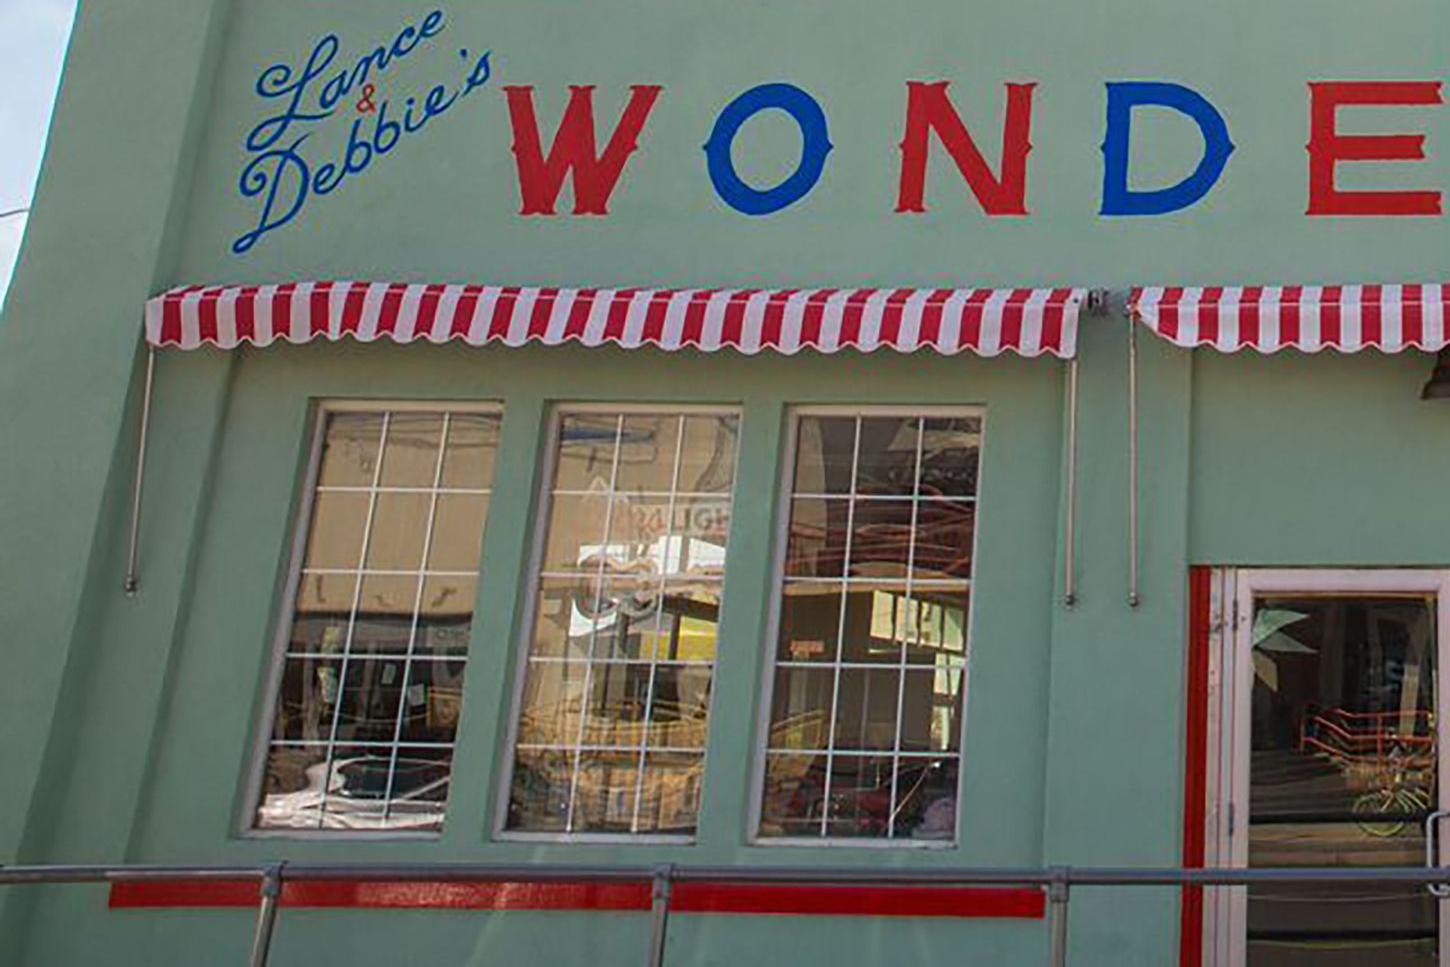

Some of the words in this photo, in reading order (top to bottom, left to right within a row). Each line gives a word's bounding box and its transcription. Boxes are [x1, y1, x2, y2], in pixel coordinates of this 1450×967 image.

[232, 48, 493, 254] Debbie's
[246, 9, 445, 152] Lance
[355, 83, 377, 113] &
